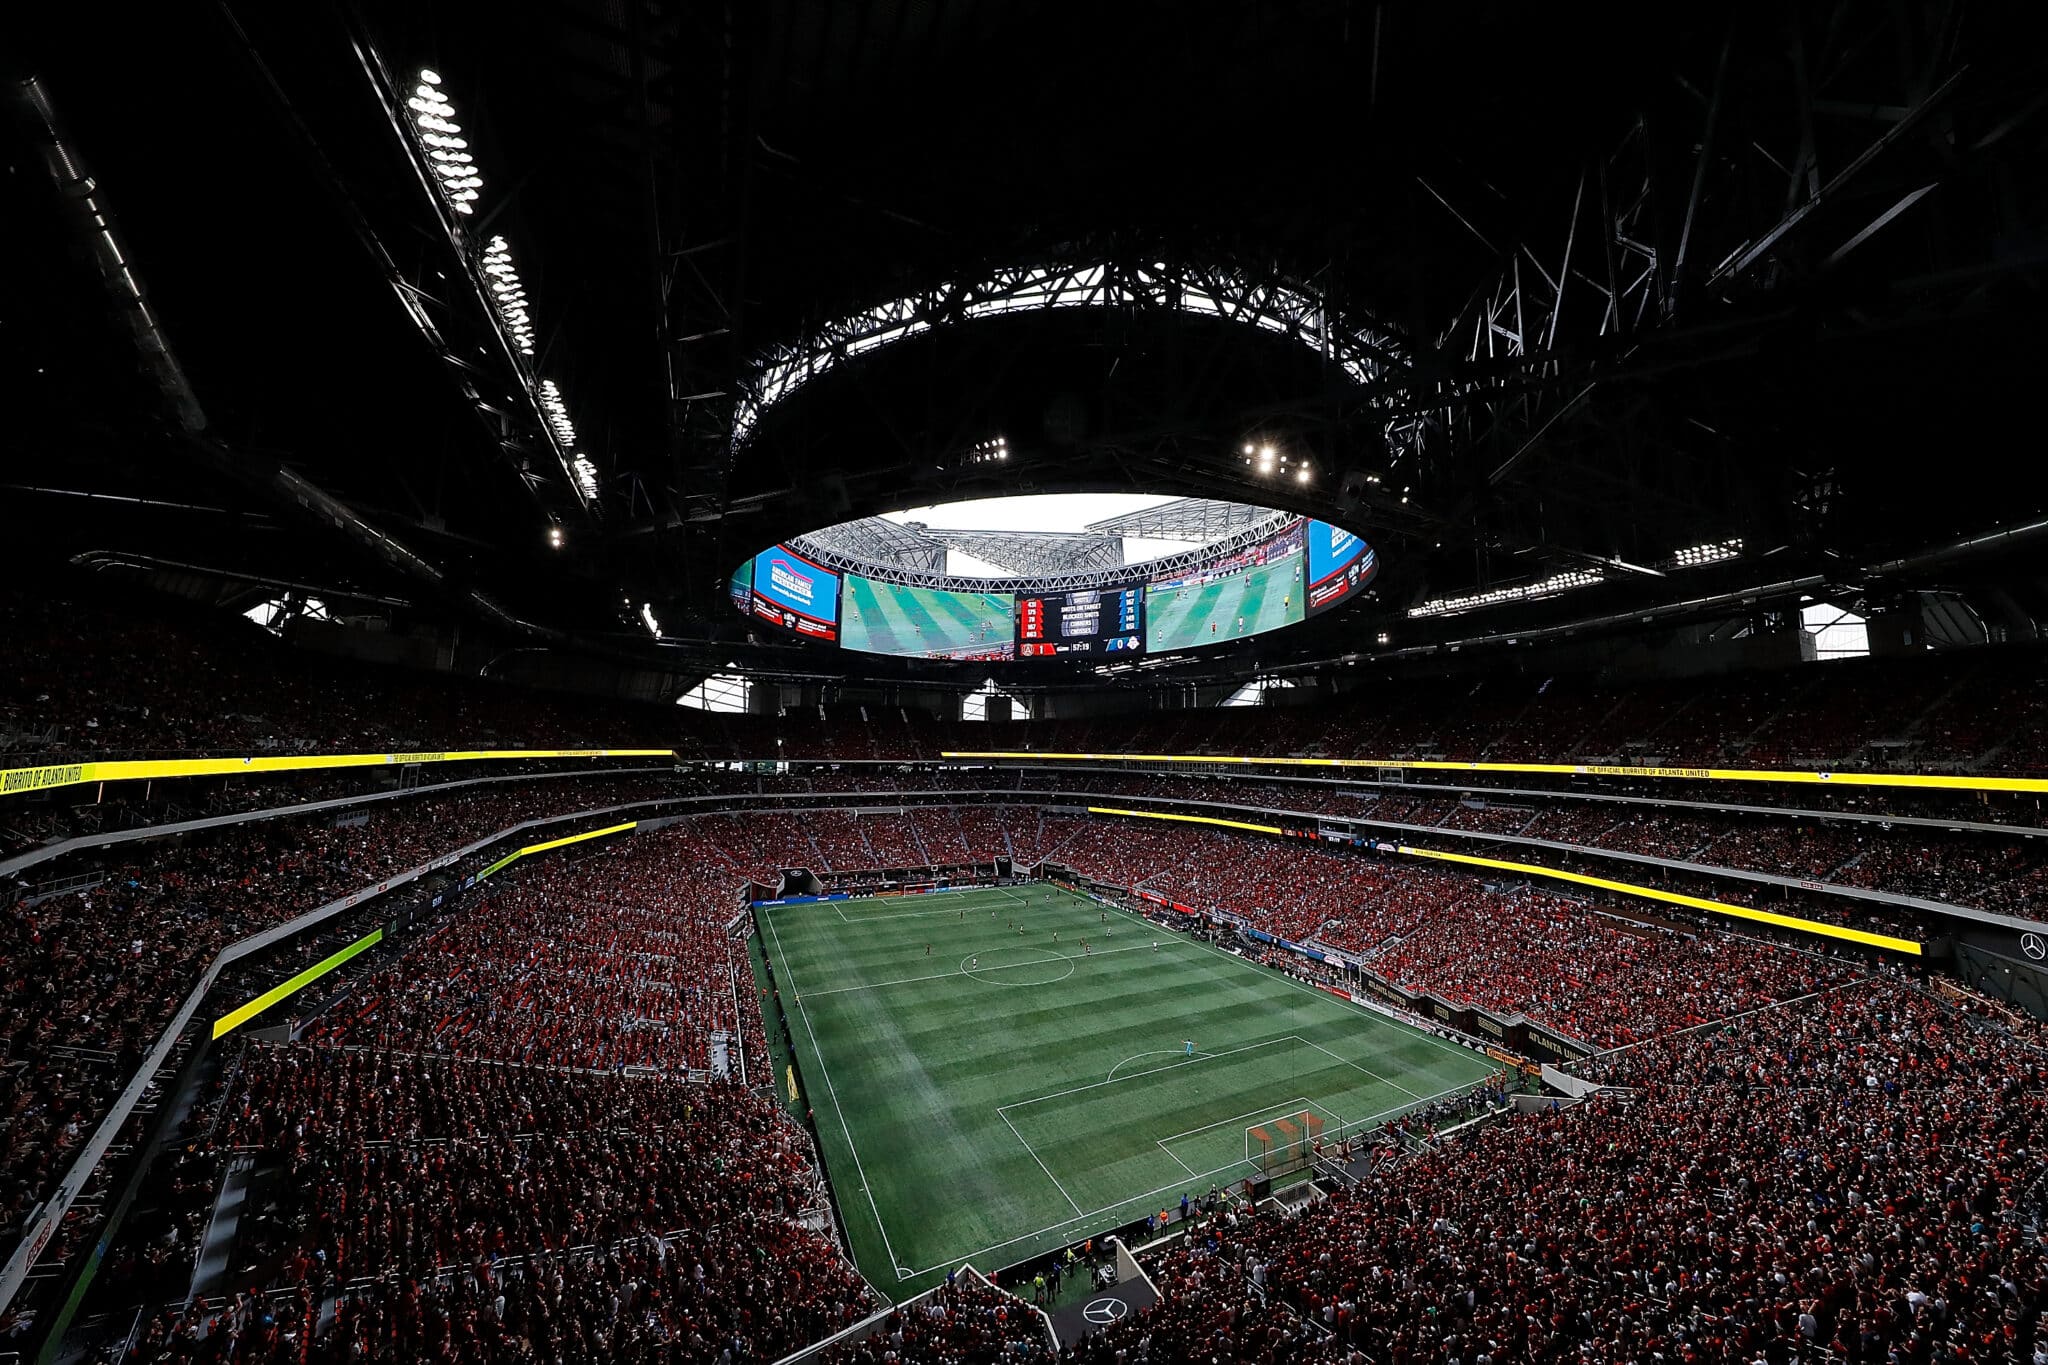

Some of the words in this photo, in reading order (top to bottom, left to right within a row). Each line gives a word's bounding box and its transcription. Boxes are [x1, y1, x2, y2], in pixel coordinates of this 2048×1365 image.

[1072, 643, 1090, 652] 57:19
[1117, 640, 1123, 649] 0
[1622, 767, 1647, 775] BURRITO
[1658, 768, 1684, 776] ATLANTA
[1685, 769, 1710, 778] UNITED
[4, 771, 33, 791] BURRITO
[33, 769, 42, 787] OF
[42, 767, 64, 785] ATLANTA
[65, 766, 82, 783] UNITED
[1528, 1031, 1562, 1055] ATLANTA
